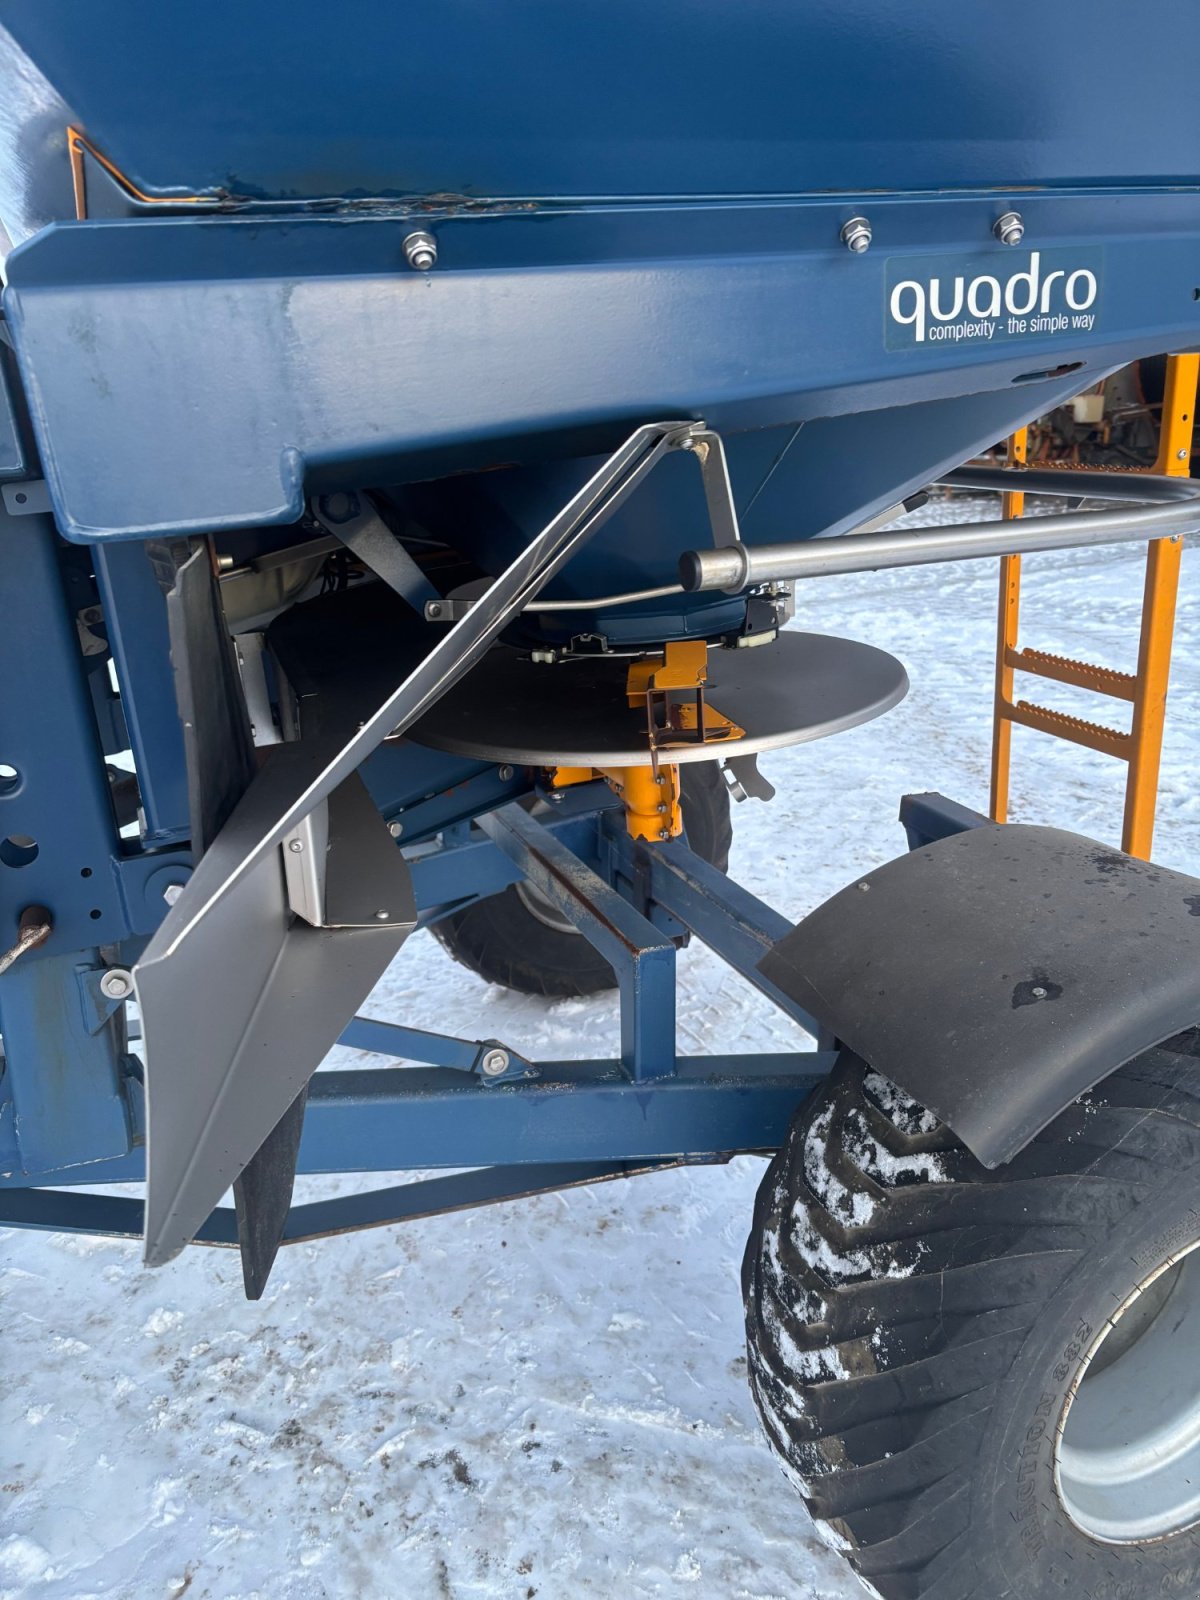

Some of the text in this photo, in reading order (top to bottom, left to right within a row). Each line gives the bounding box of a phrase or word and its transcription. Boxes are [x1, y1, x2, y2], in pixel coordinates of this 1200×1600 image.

[890, 252, 1097, 342] quadro
[929, 319, 995, 342] complexity
[1008, 317, 1027, 334] the
[1030, 313, 1069, 334] simple
[1071, 313, 1095, 331] way
[1052, 1322, 1093, 1382] 882
